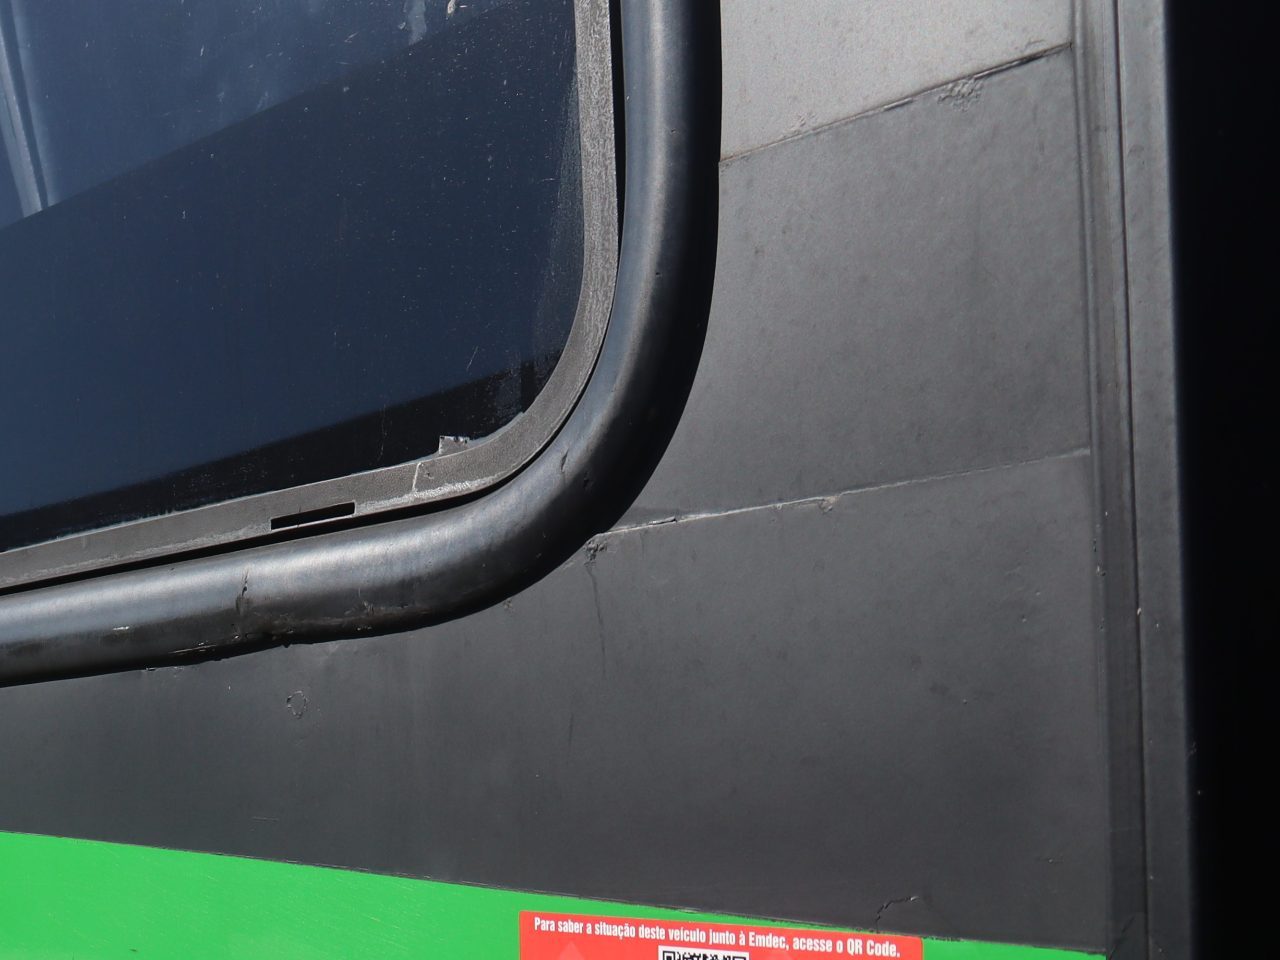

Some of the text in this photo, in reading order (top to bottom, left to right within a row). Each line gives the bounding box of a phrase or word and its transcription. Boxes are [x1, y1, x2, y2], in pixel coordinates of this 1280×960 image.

[534, 917, 901, 958] Para saber a situação deste veículo junto à Emdec, acesse o QR Code.
